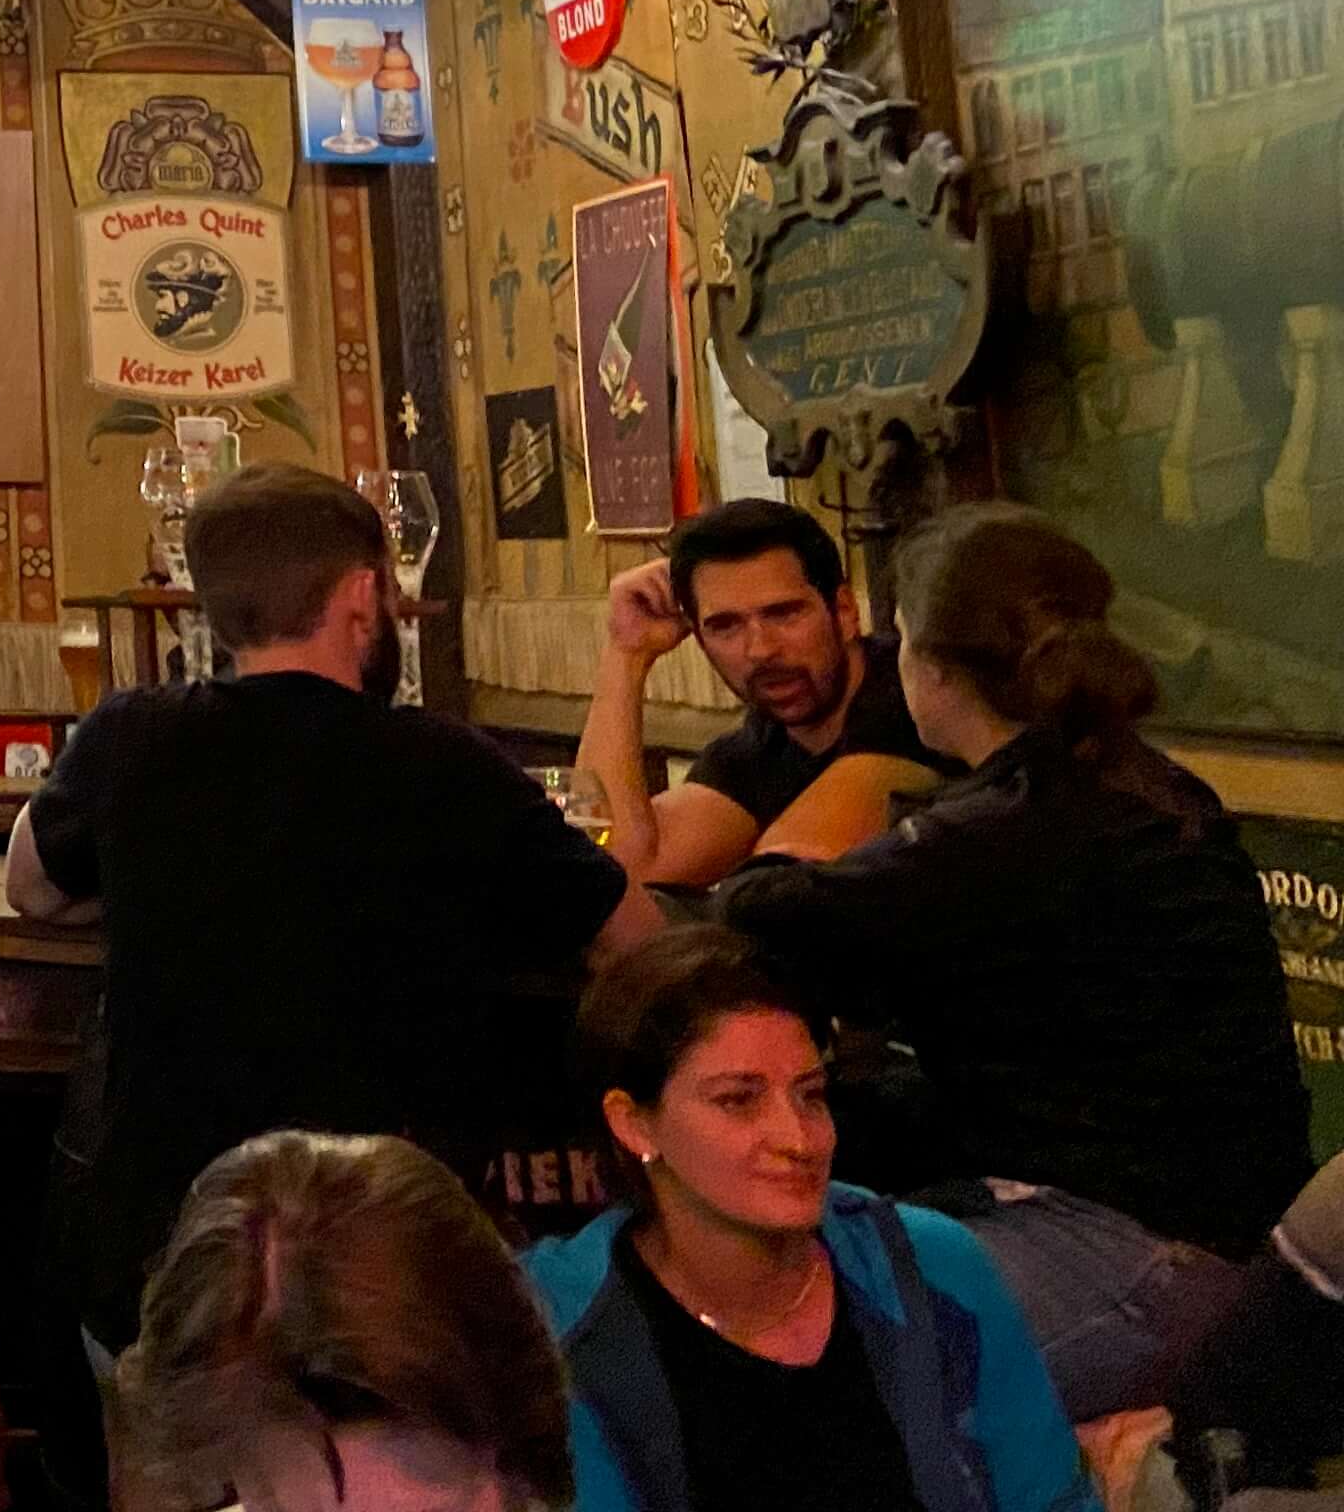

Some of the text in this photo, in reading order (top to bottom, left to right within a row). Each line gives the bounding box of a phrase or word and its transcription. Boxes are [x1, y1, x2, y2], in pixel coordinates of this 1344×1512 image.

[101, 204, 267, 241] Charles Quint
[119, 356, 267, 390] Keizer Karel
[1256, 869, 1344, 926] RDO
